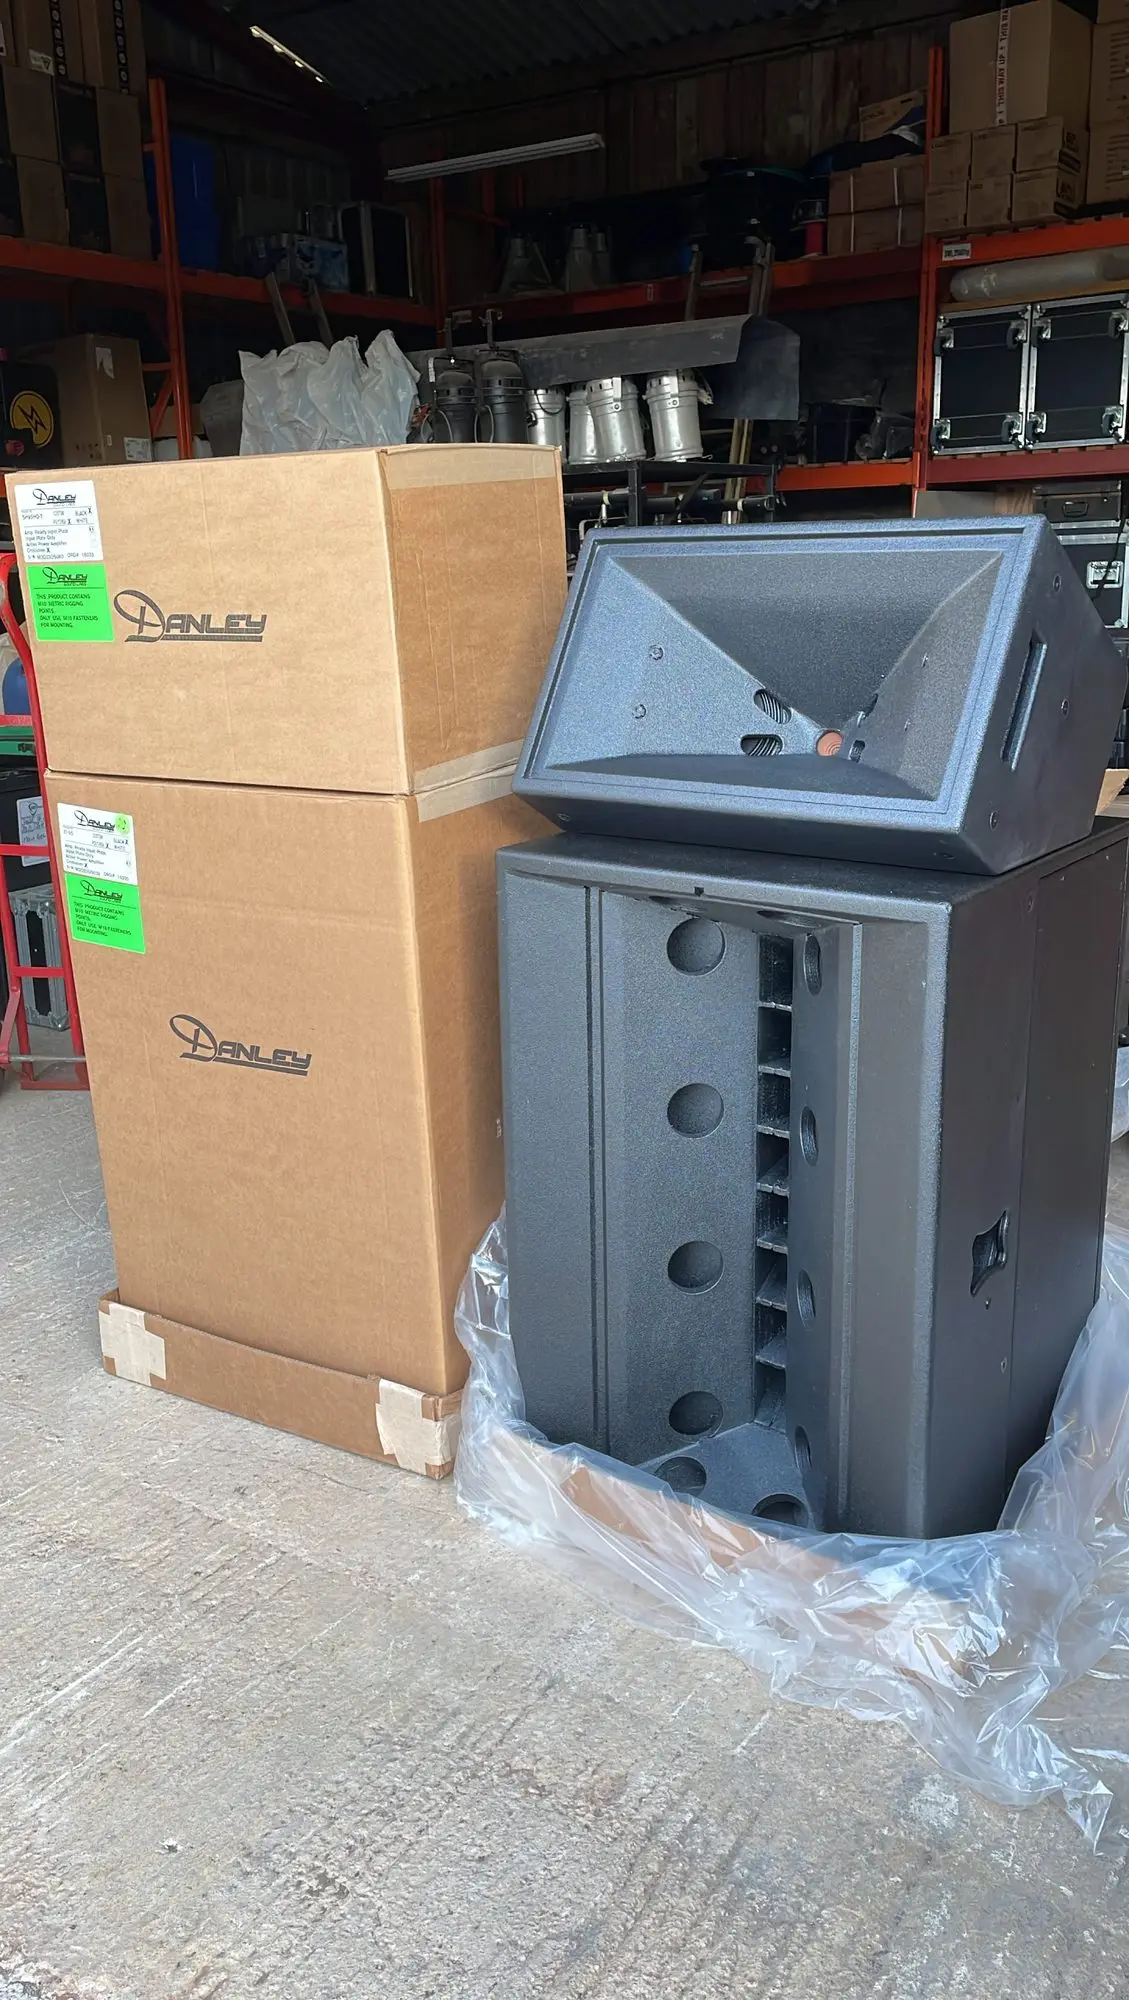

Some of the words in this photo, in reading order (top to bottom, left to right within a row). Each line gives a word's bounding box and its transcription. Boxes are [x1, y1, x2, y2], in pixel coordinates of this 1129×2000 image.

[42, 566, 87, 584] DANLEY
[114, 589, 268, 642] DANLEY
[80, 880, 123, 901] DANLEY
[84, 903, 104, 912] PRODUCT
[104, 907, 125, 916] CONTAINS
[169, 1014, 312, 1076] DANLEY
